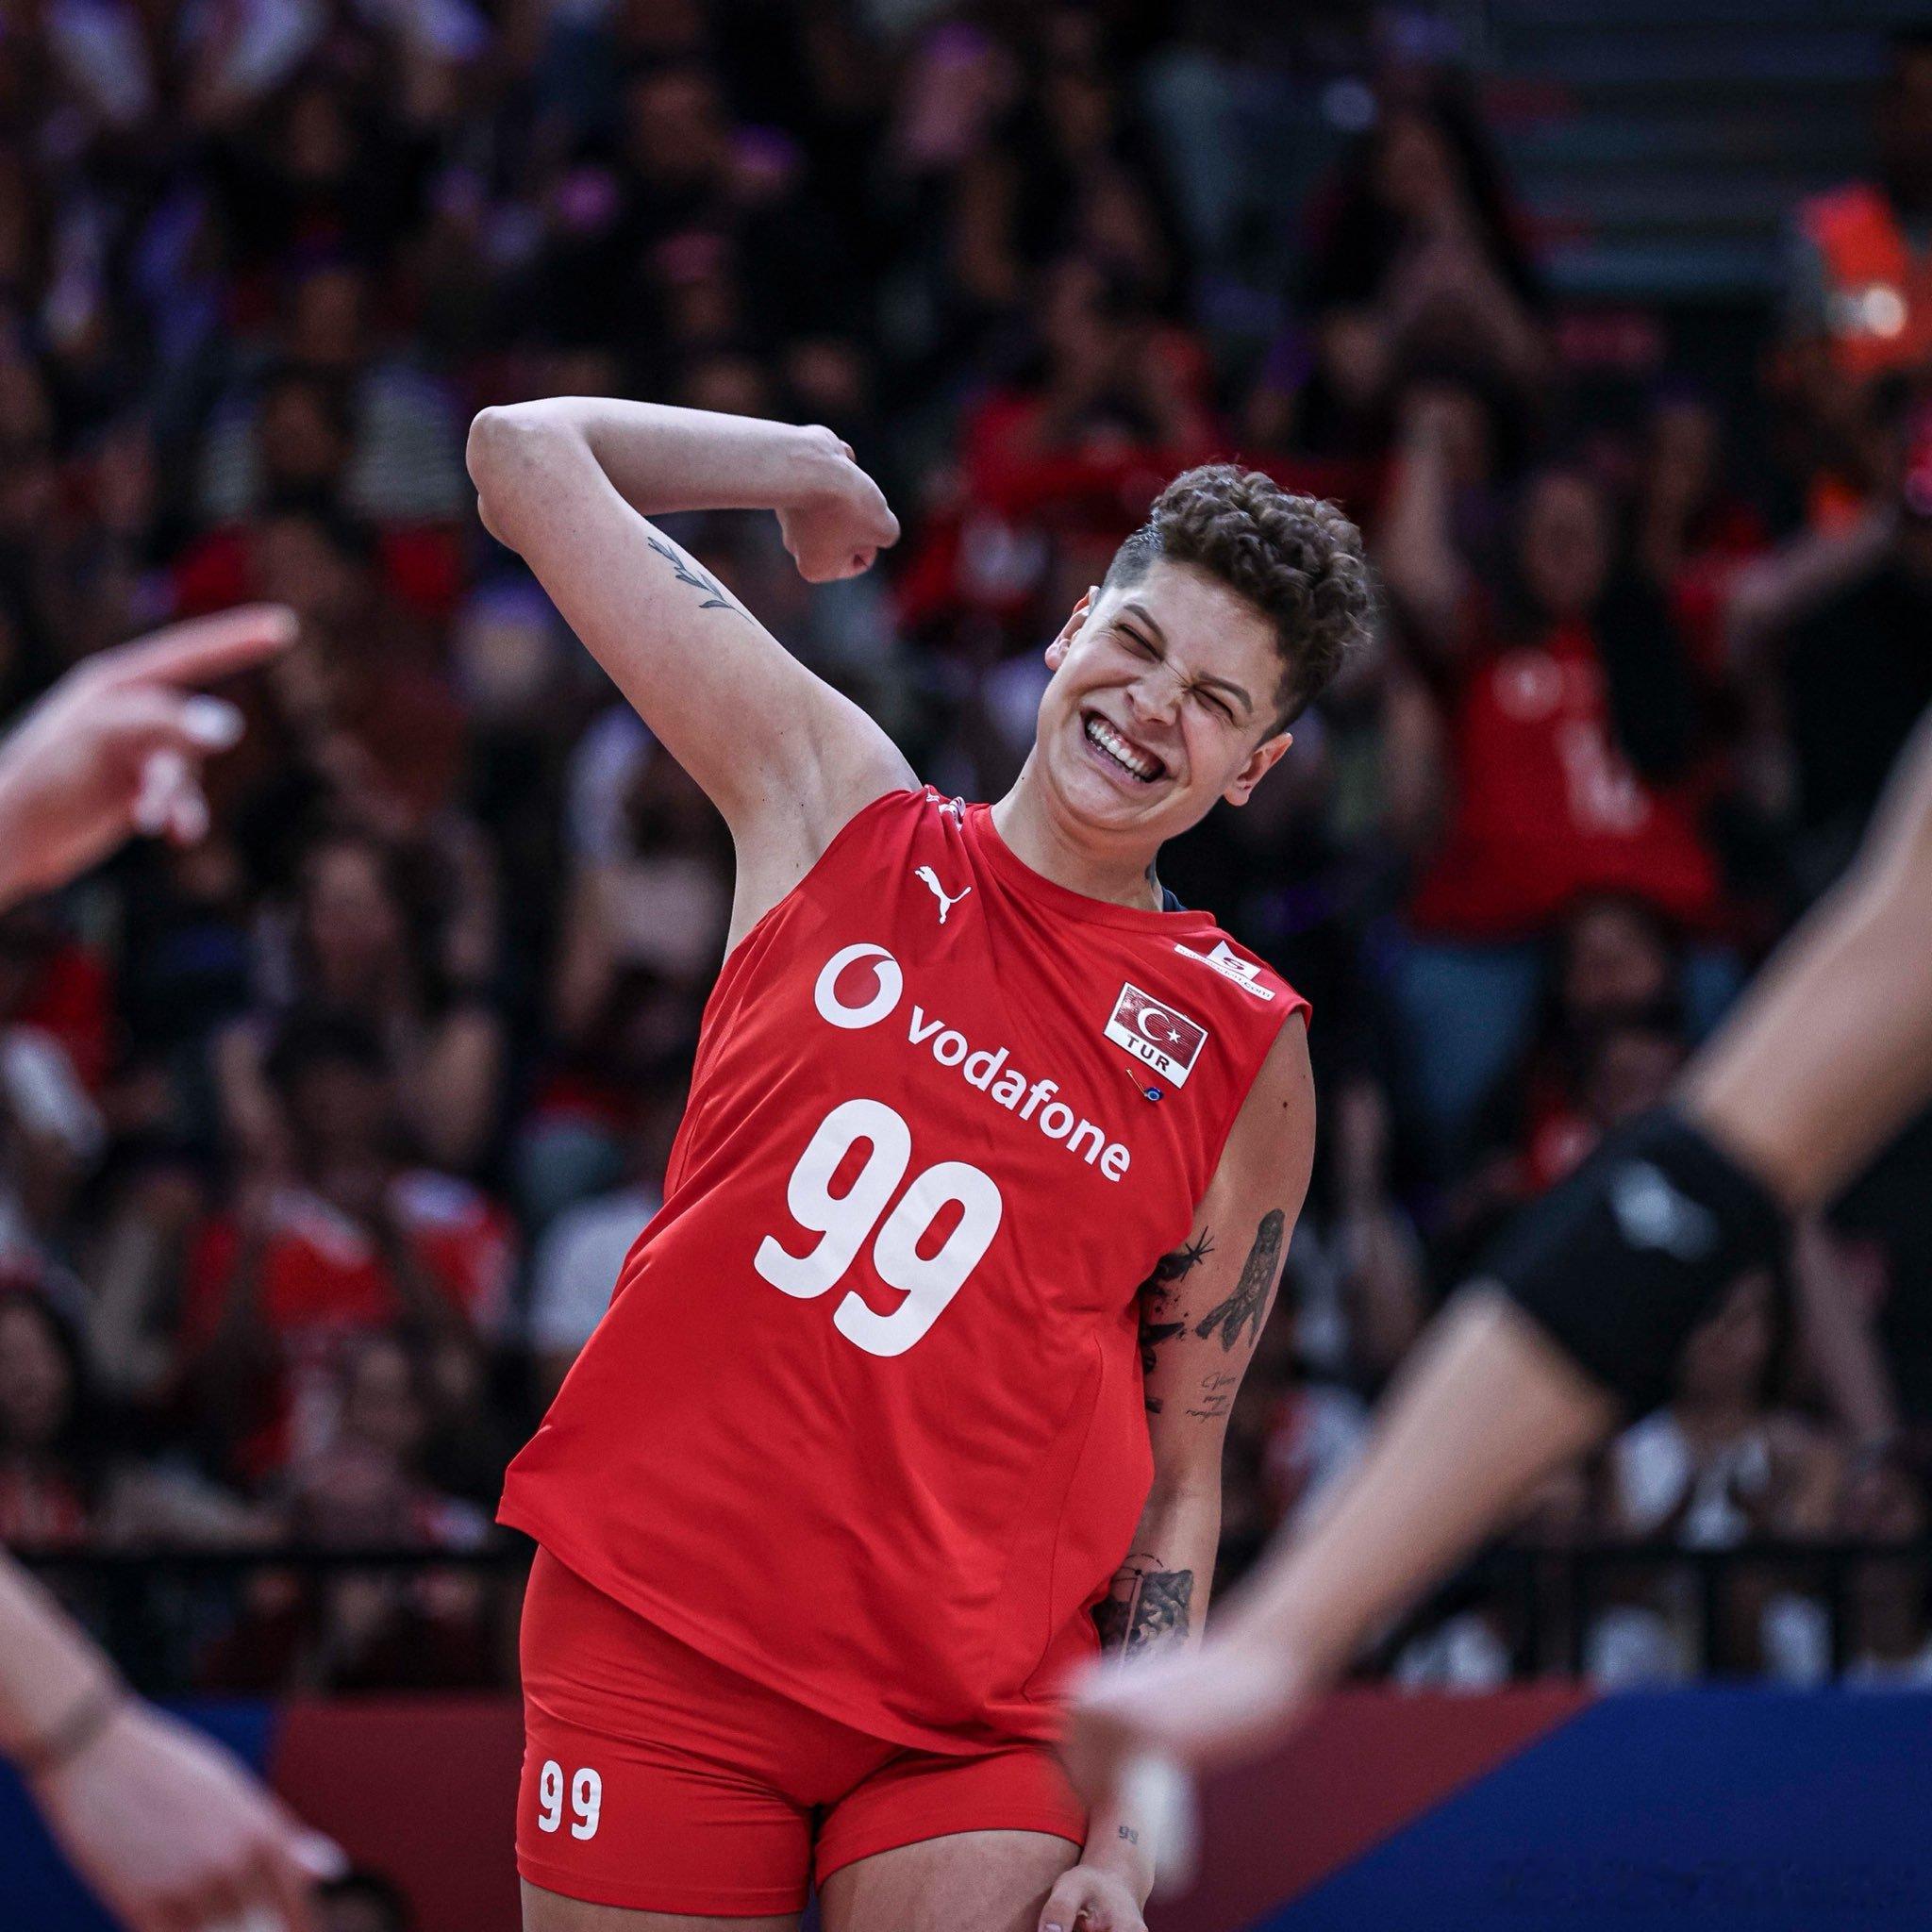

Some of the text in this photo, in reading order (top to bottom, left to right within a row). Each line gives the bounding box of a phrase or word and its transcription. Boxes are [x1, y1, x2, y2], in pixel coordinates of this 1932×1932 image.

[908, 1005, 1131, 1182] vodafone
[1126, 1034, 1171, 1073] TUR
[753, 1098, 1003, 1357] 99
[538, 1759, 603, 1840] 99
